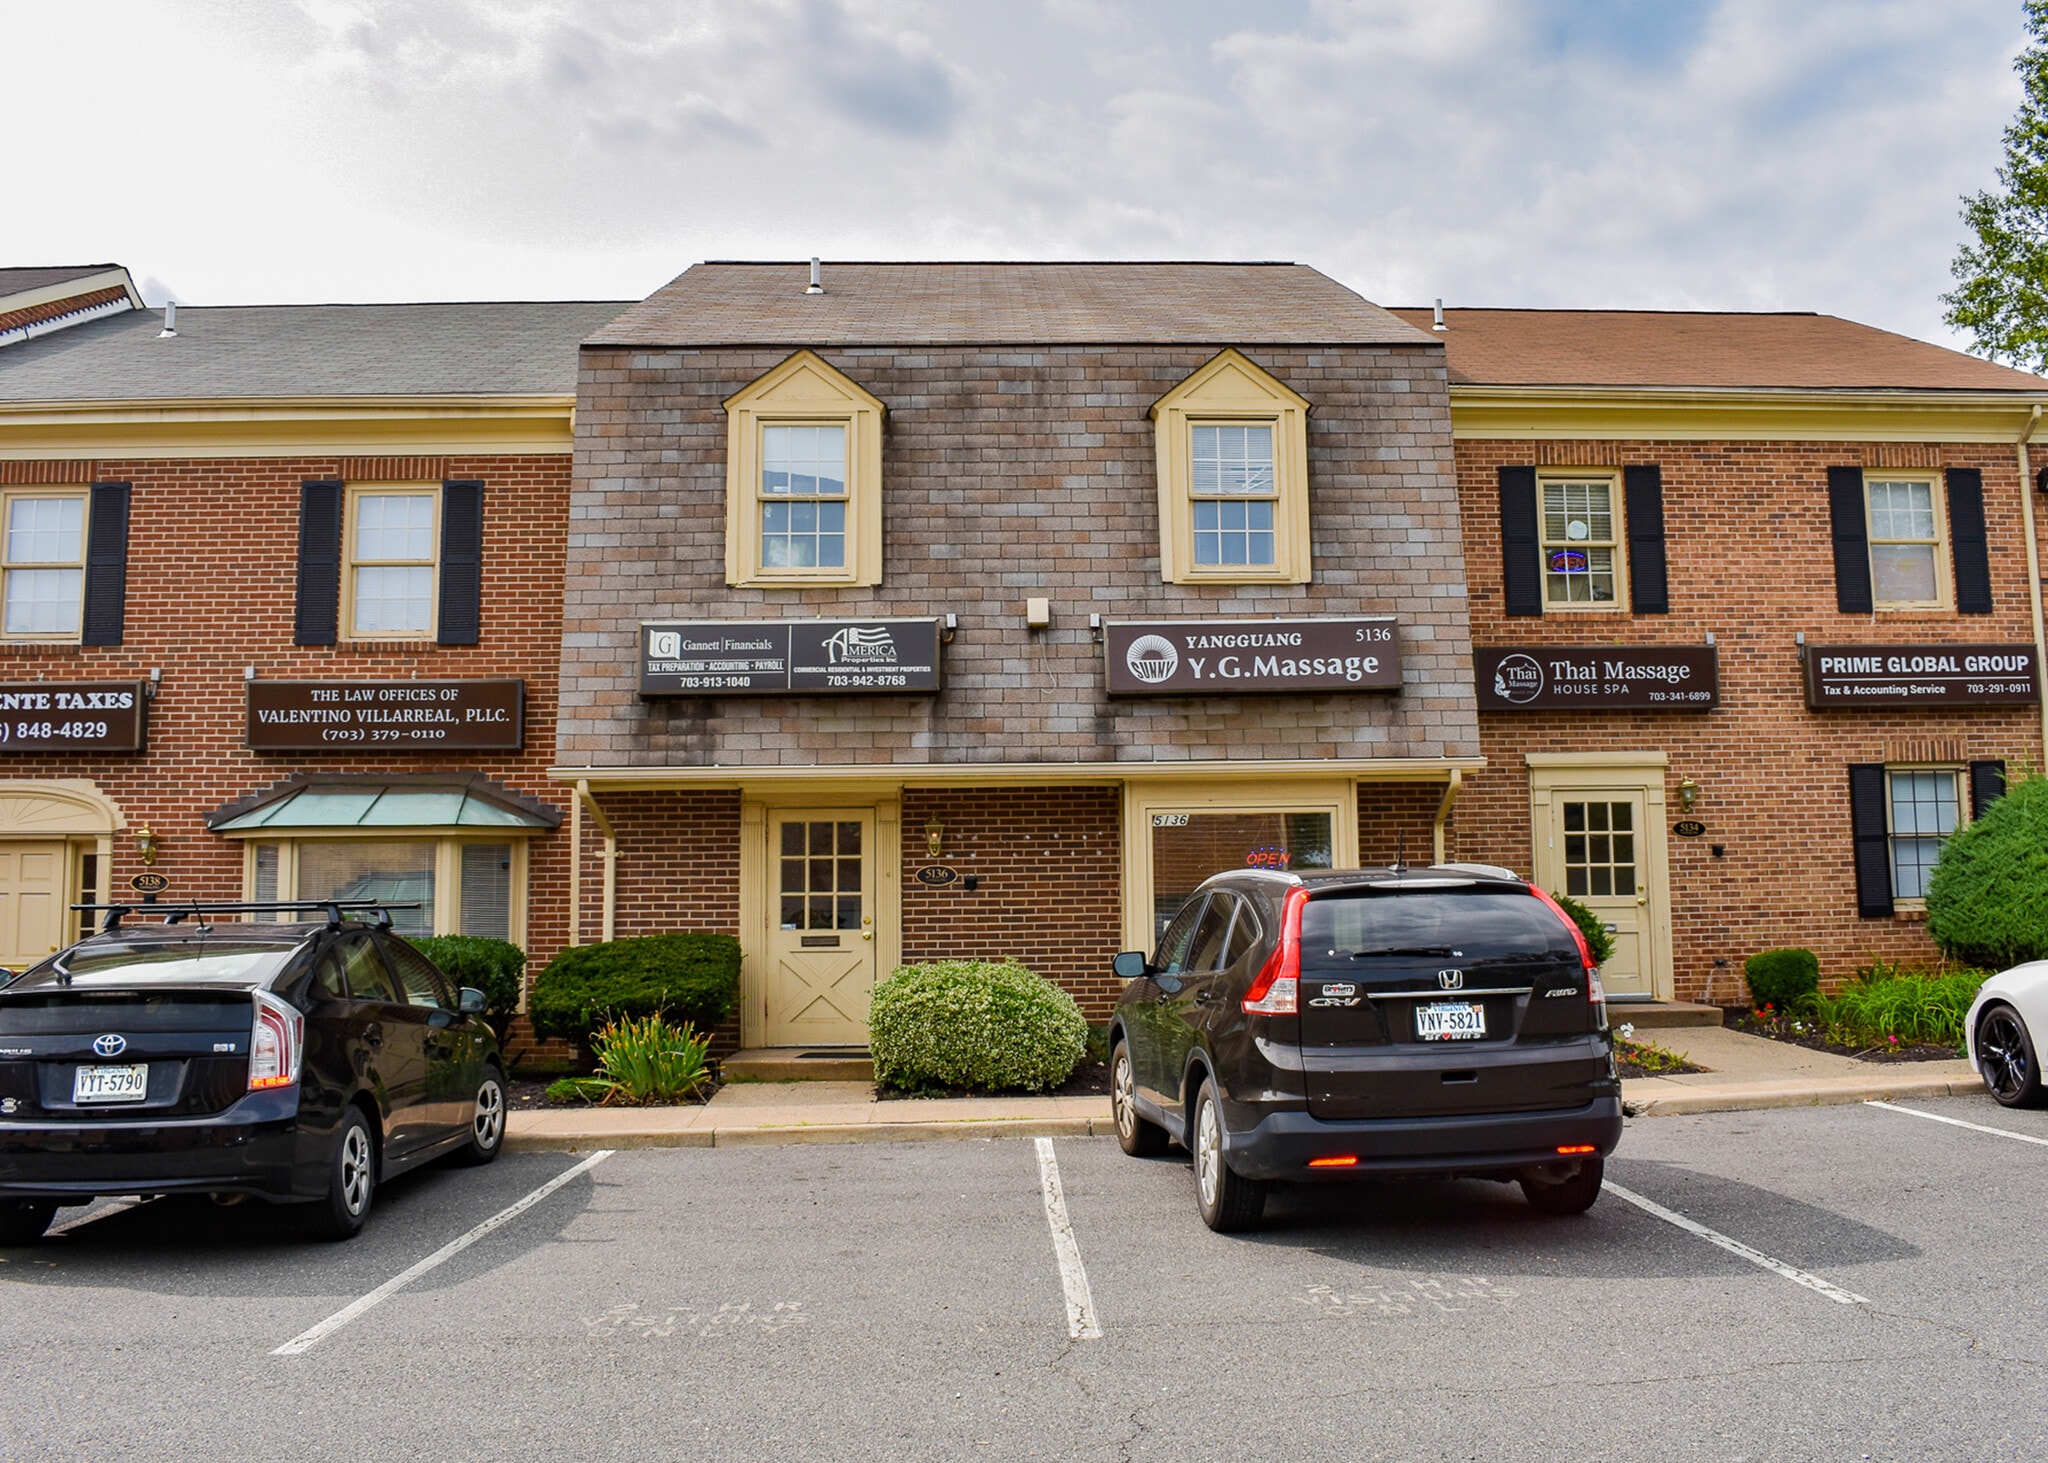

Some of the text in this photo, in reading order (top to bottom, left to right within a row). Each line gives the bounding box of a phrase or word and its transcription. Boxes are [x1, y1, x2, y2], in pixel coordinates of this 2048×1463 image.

[1551, 557, 1586, 569] OPEN
[1186, 633, 1302, 648] YANGGUANG
[1356, 629, 1390, 641] 5136
[659, 635, 671, 654] G
[683, 639, 772, 650] Gannett Financials
[822, 628, 897, 664] AMERICA
[649, 661, 784, 671] TAX PREPARATION ACCOUNTING PAYROLL
[1131, 661, 1174, 678] SUNNY
[1188, 656, 1378, 681] Y.G.Massage
[1821, 656, 2029, 673] PRIME GLOBAL GROUP
[1507, 667, 1537, 680] Thai
[1550, 661, 1690, 683] Thai Massage
[681, 677, 750, 687] 703-913-1040
[827, 676, 906, 686] 703-942-8768
[1509, 680, 1537, 688] Massage
[1554, 684, 1629, 694] HOUSE SPA
[1824, 684, 1946, 696] Tax & Accounting Service
[1967, 684, 2030, 693] 703-291-0911
[55, 692, 133, 709] TAXES
[311, 689, 458, 701] THE LAW OFFICES OF
[1650, 691, 1710, 701] 703-341-6899
[258, 709, 510, 724] VALENTINO VILLARREAL, PLLC.
[17, 721, 107, 738] 848-4829
[322, 729, 446, 741] (703) 379-0110
[1154, 815, 1187, 826] 5136
[1680, 823, 1698, 831] 5134
[1247, 852, 1291, 865] OPEN
[926, 869, 948, 879] 5136
[139, 876, 161, 885] 5138
[1545, 988, 1577, 997] AWD
[1309, 998, 1361, 1006] CR-V
[81, 1074, 142, 1092] VYT-5790
